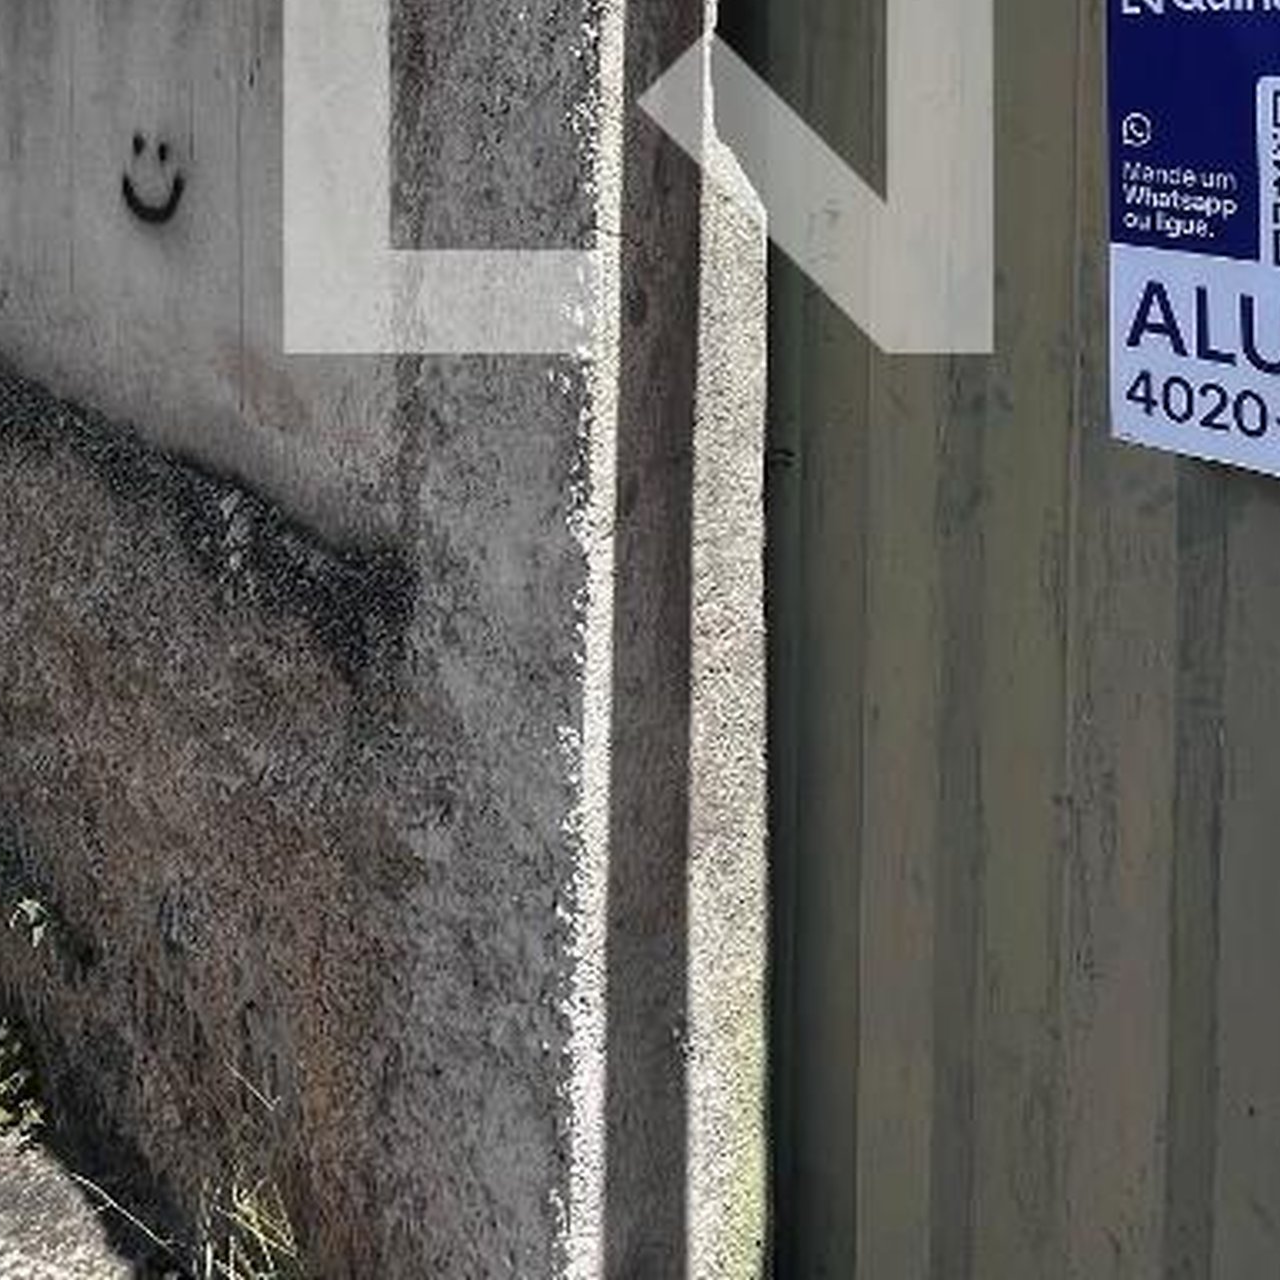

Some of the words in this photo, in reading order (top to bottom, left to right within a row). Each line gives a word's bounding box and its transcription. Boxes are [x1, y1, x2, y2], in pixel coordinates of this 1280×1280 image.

[1123, 162, 1196, 188] Mande
[1200, 172, 1238, 191] um
[1122, 212, 1151, 231] ou
